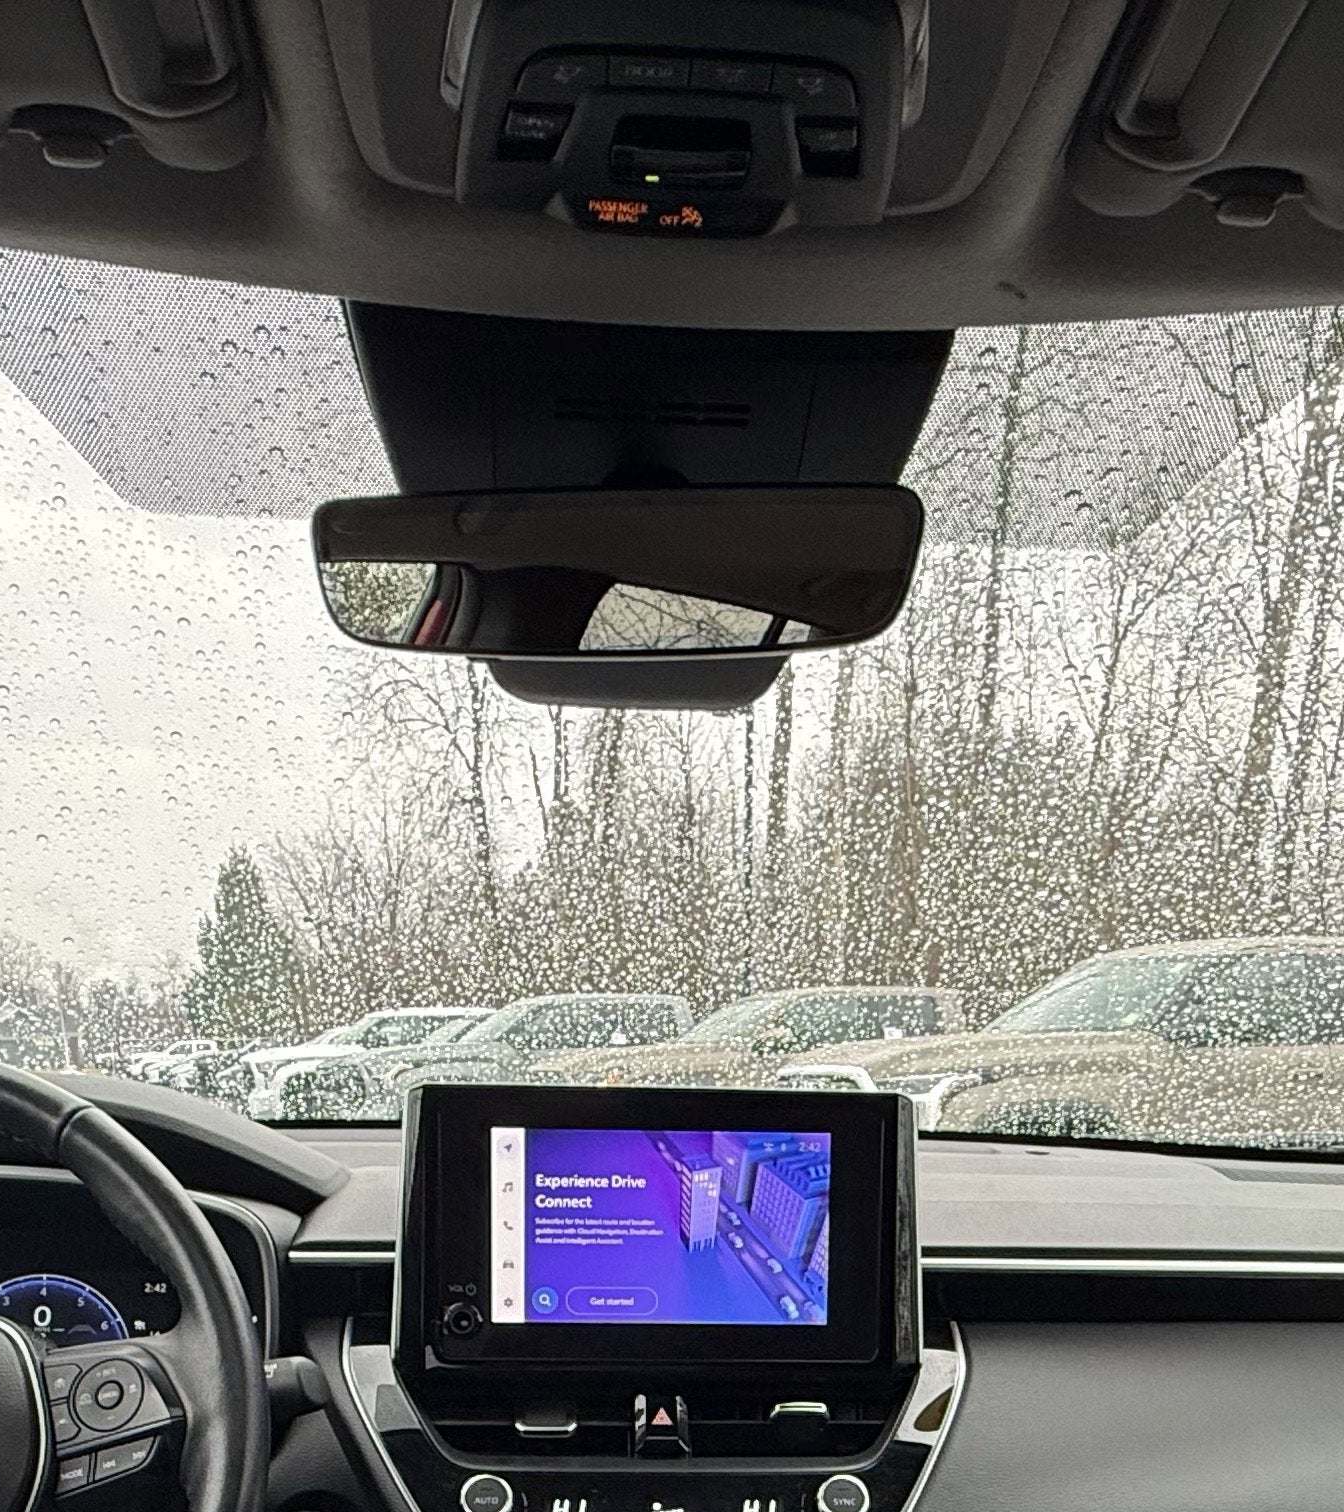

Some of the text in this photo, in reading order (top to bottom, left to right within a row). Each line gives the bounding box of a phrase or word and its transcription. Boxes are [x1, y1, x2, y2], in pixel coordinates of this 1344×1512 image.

[589, 199, 648, 214] PASSENGER
[598, 211, 639, 223] AIR BAG
[659, 215, 680, 226] OFF
[799, 1142, 821, 1152] 2:42
[535, 1173, 646, 1190] Experience Drive
[535, 1194, 592, 1208] Connect
[39, 1287, 47, 1297] 4
[144, 1283, 167, 1293] 2:42
[3, 1296, 85, 1307] 3 5
[589, 1296, 634, 1306] Get started
[33, 1305, 52, 1327] 0
[101, 1321, 109, 1331] 6
[61, 1467, 84, 1480] MODE
[474, 1496, 498, 1505] AUTO
[833, 1497, 857, 1507] SYNC
